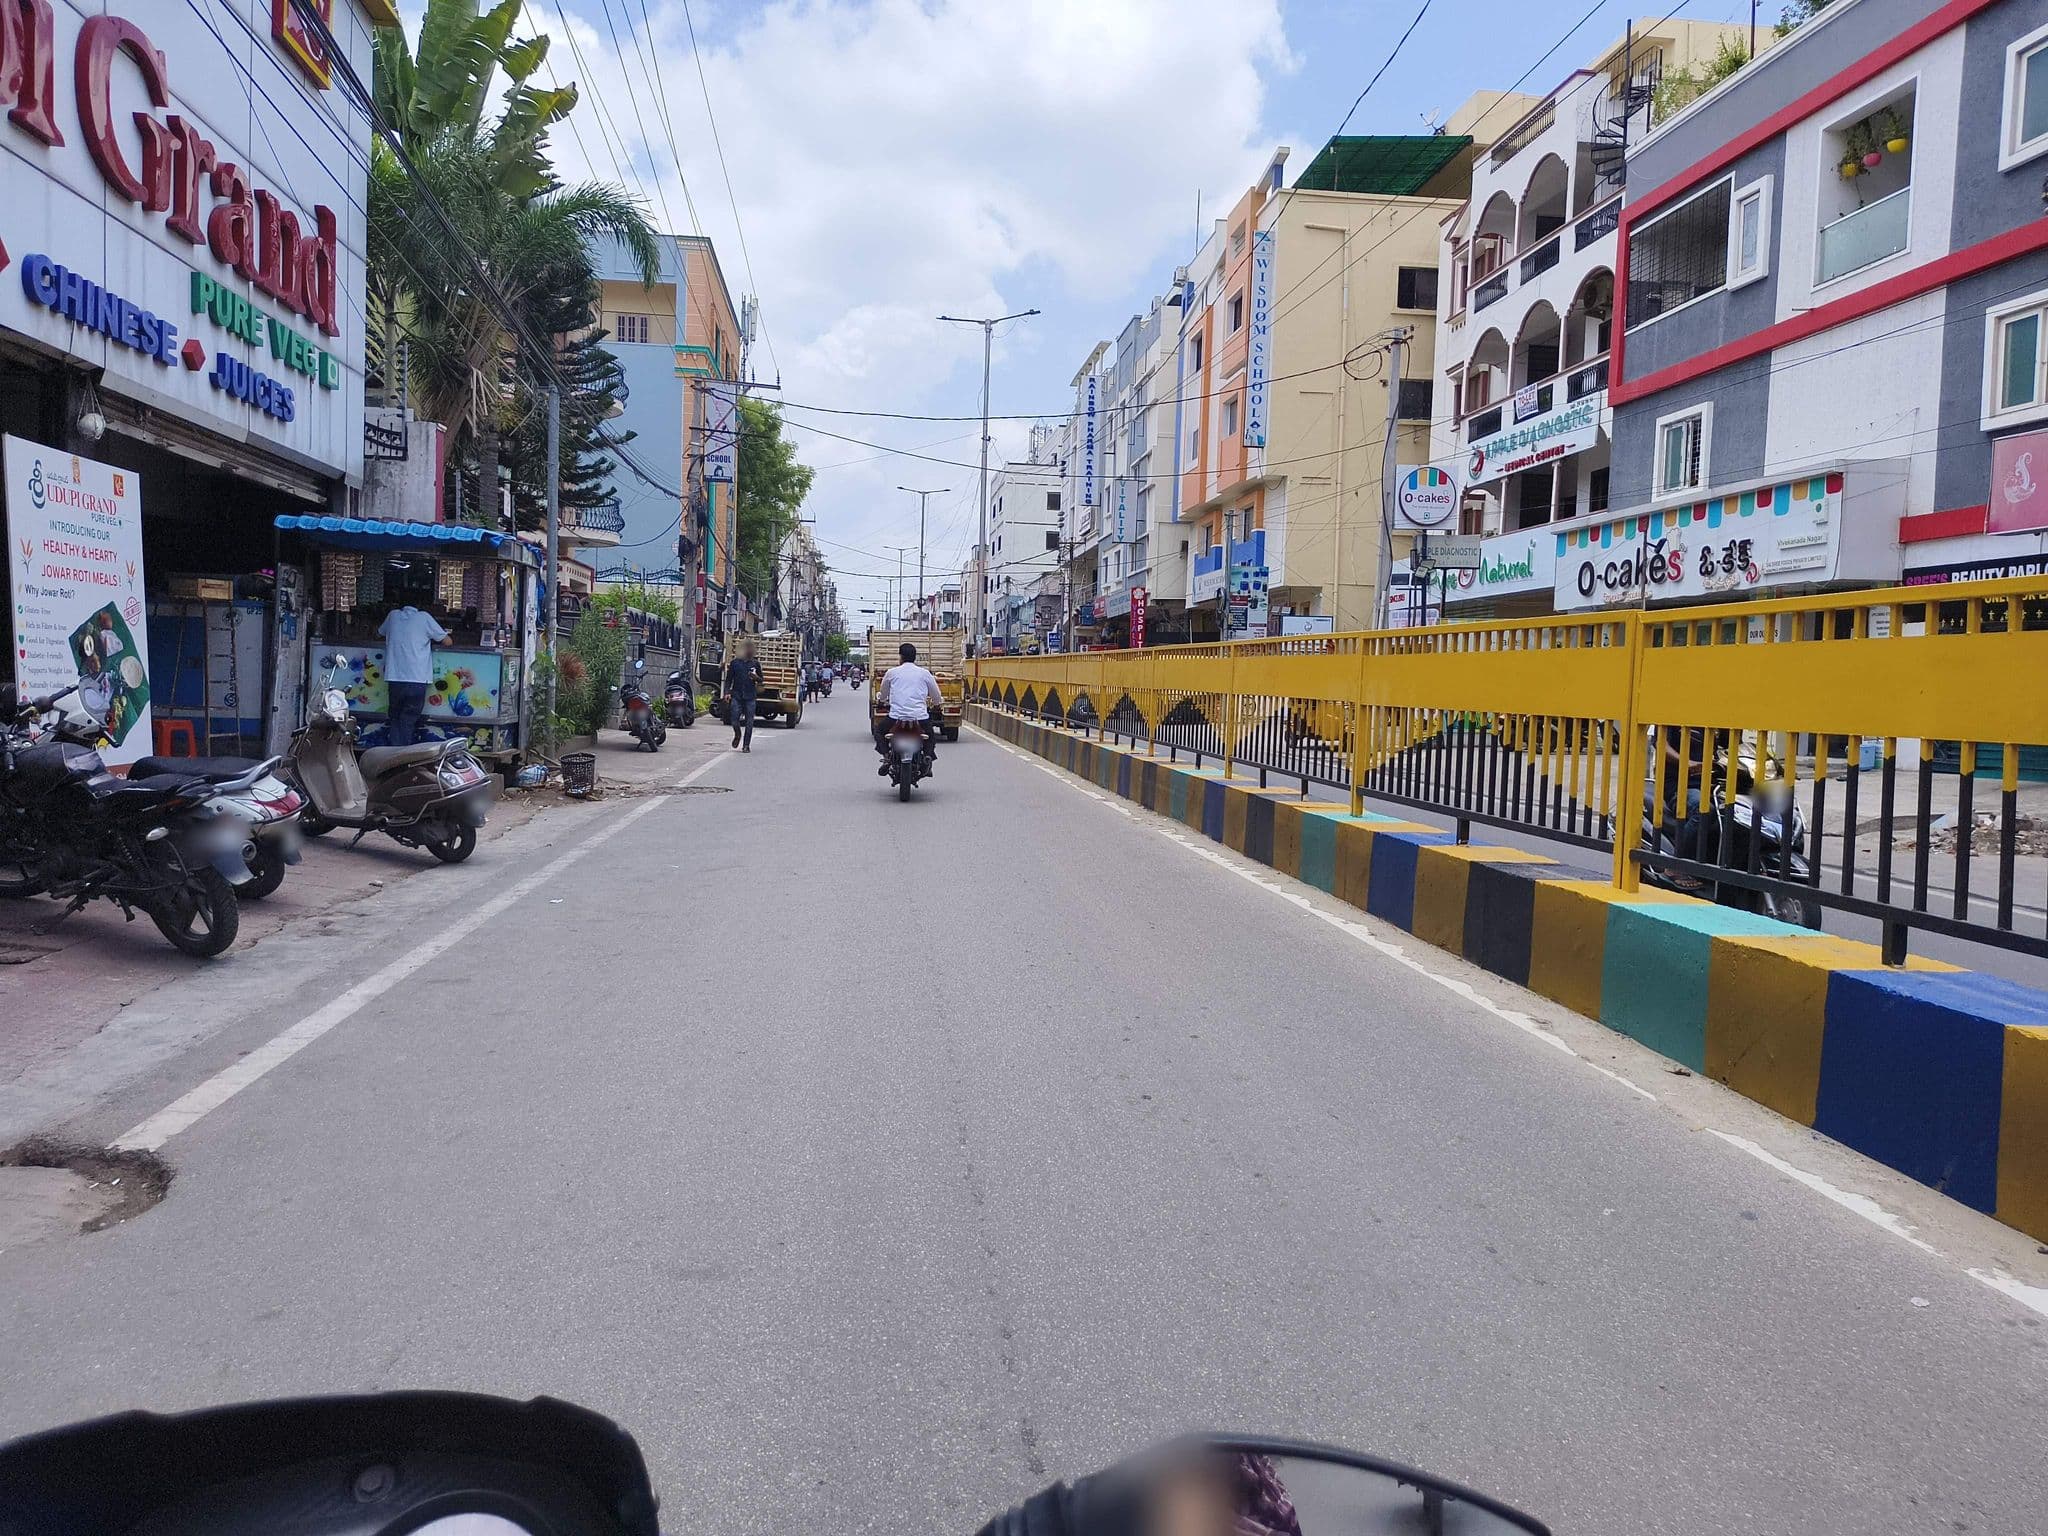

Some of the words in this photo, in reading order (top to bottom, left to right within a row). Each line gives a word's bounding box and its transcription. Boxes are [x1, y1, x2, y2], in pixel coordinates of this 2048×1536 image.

[74, 15, 340, 337] Grand
[21, 254, 178, 367] CHINESE
[190, 271, 263, 347] PURE
[1254, 259, 1270, 335] WISDOM
[209, 352, 296, 423] JUICES
[1087, 377, 1096, 417] RAINBOW
[1251, 343, 1264, 418] SCHOOL
[1086, 422, 1095, 456] PHARMA
[1519, 404, 1594, 447] DIAGNOSTIC
[706, 454, 732, 464] SCHOOL
[47, 483, 80, 508] UDUPI
[82, 493, 117, 516] GRAND
[1085, 459, 1094, 504] TRAINING
[1404, 492, 1450, 504] O-cakes
[50, 520, 96, 538] INTRODUCING
[97, 529, 111, 541] OUR
[1117, 480, 1126, 542] VITALITY
[43, 539, 80, 558] HEALTHY
[82, 546, 87, 558] &
[89, 548, 118, 563] HEARTY
[1440, 546, 1478, 557] DIAGNOSTIC
[1478, 547, 1534, 586] Natural
[2008, 563, 2048, 577] PARL
[25, 584, 39, 598] Why
[40, 585, 59, 597] Jowar
[41, 565, 74, 581] JOWAR
[74, 569, 91, 582] ROTI
[1578, 546, 1682, 597] O-cakes
